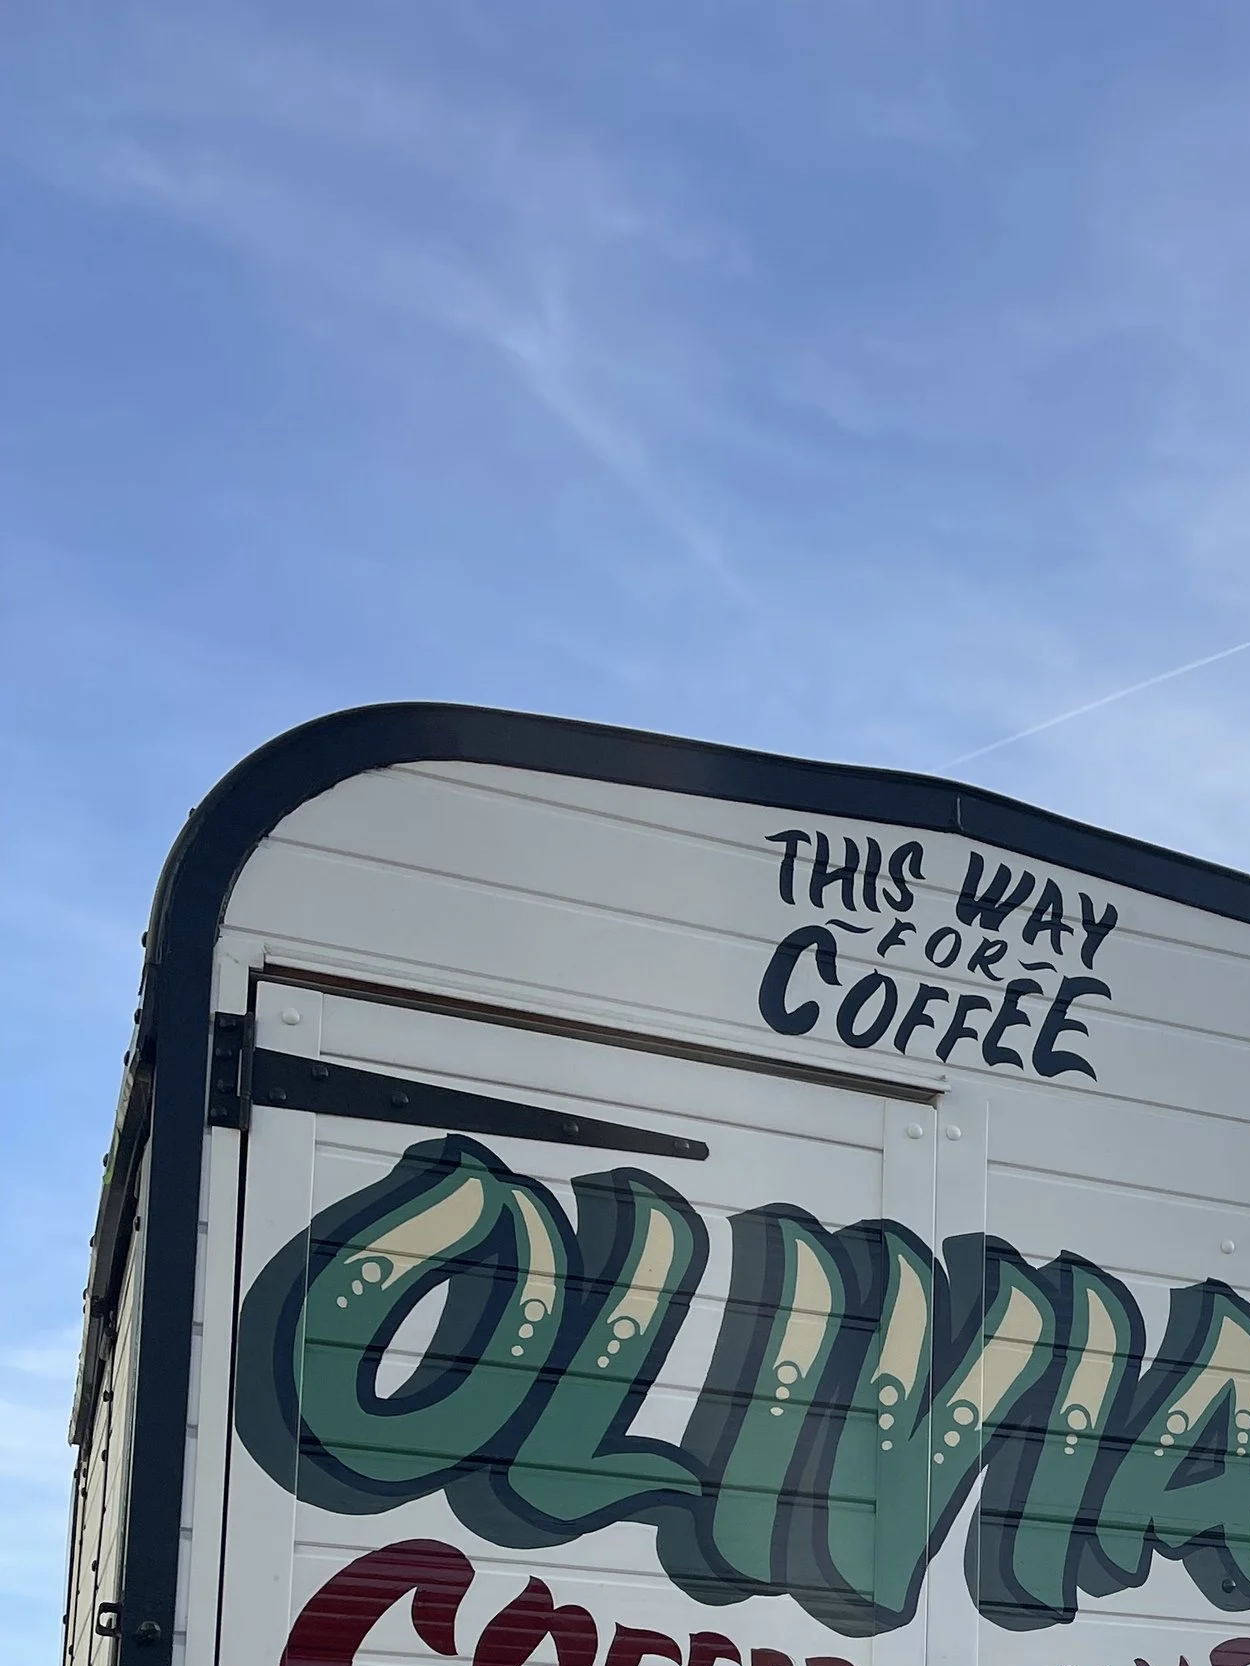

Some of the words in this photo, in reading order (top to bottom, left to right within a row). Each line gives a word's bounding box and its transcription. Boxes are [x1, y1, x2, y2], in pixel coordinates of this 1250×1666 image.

[765, 829, 926, 913] THIS
[956, 850, 1118, 970] WAY
[876, 917, 1010, 981] FOR
[758, 924, 1112, 1082] COFFEE
